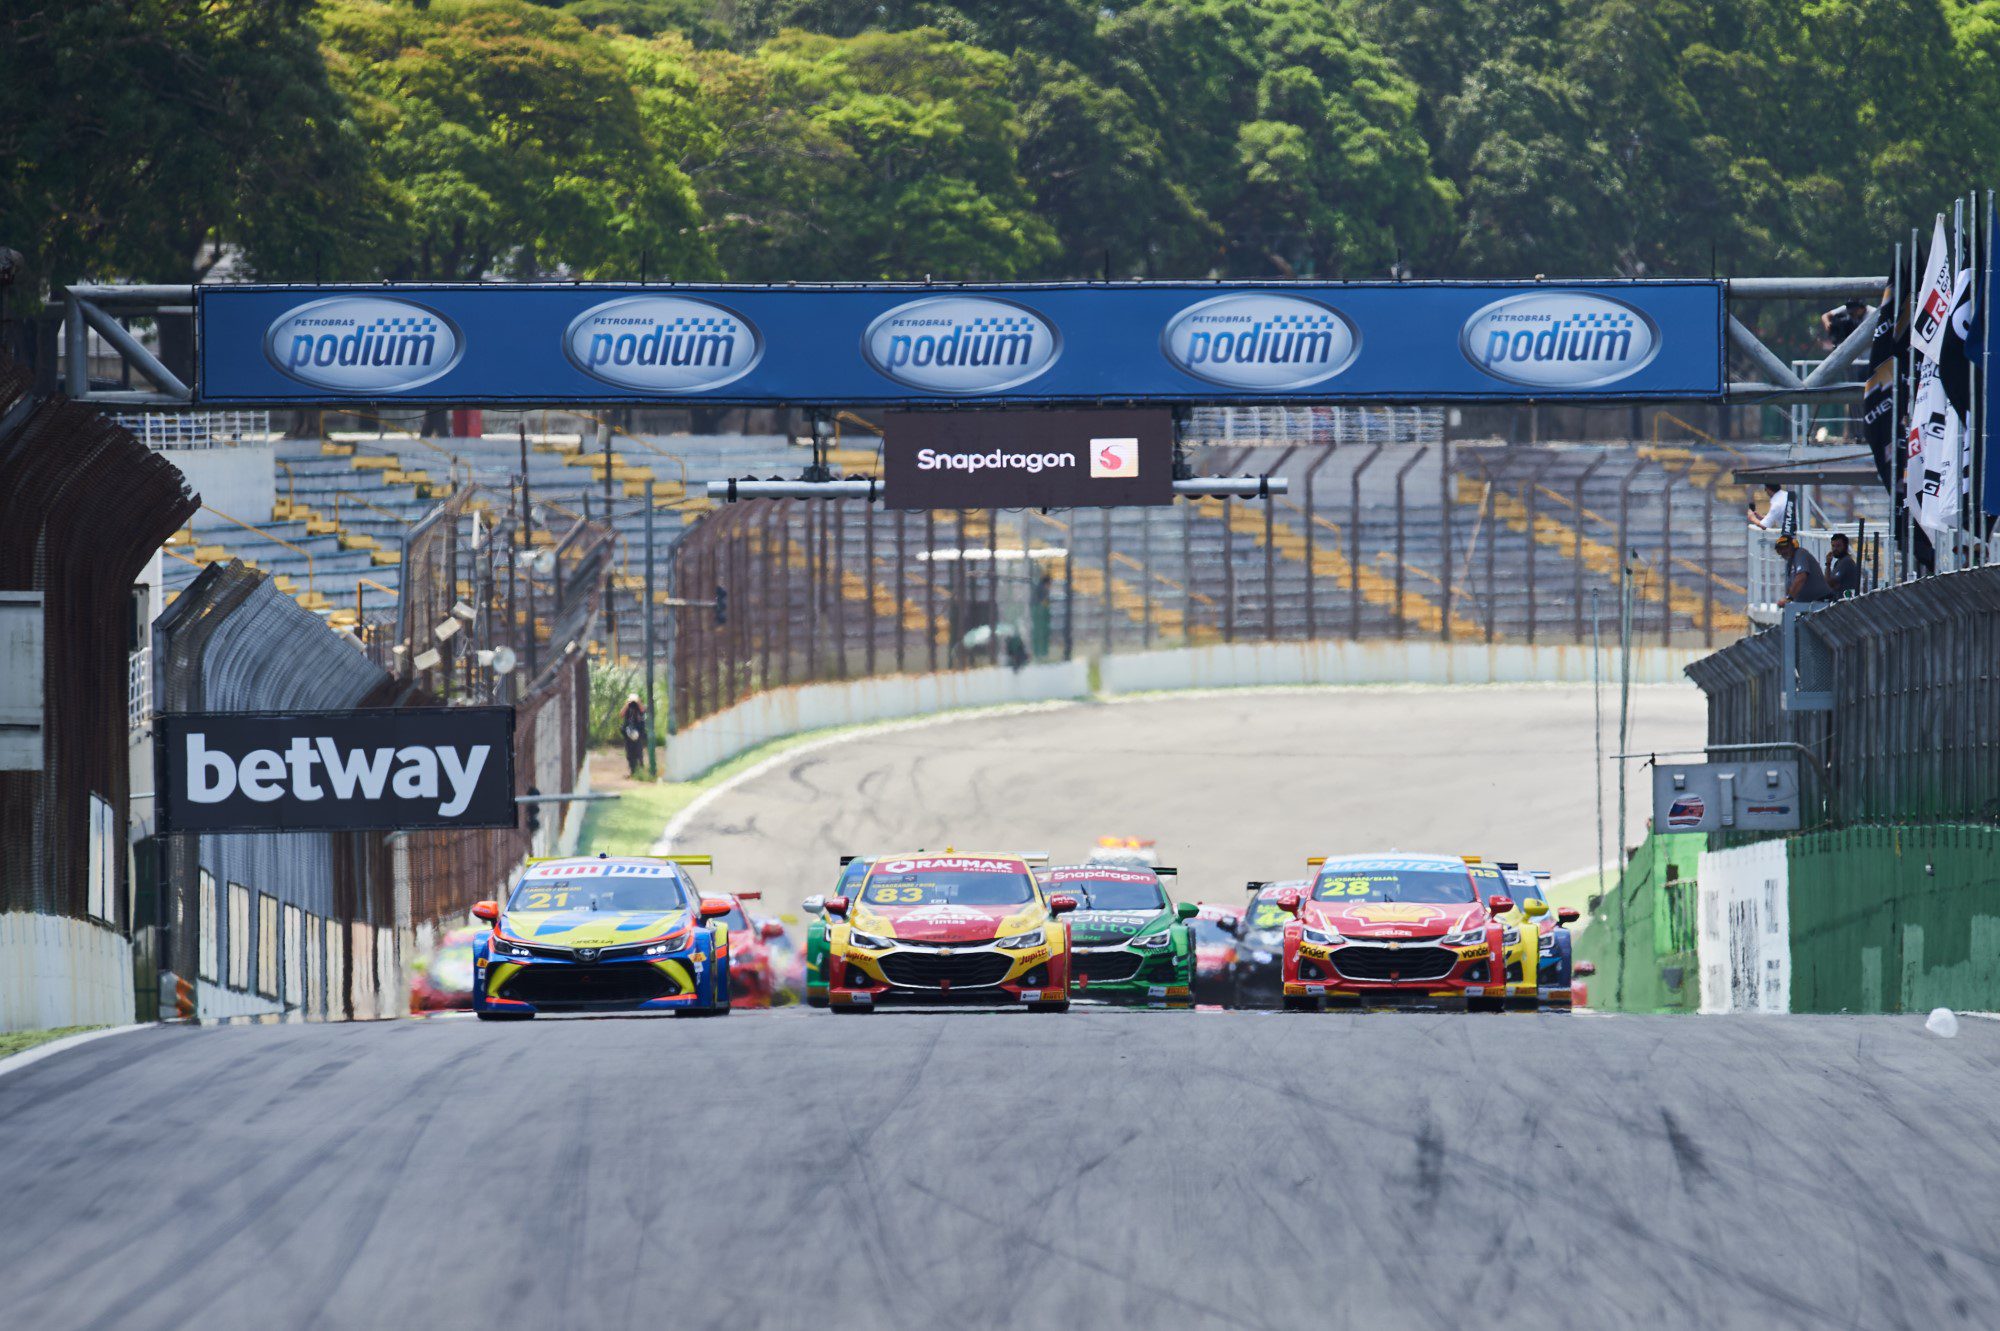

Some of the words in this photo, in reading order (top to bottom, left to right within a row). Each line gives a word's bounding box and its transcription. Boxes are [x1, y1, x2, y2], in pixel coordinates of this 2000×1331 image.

[294, 318, 356, 326] PETROBRAS
[593, 317, 655, 325] PETROBRAS
[891, 318, 954, 327] PETROBRAS
[1191, 315, 1253, 324] PETROBRAS
[1490, 314, 1552, 322] PETROBRAS
[287, 325, 436, 373] podium
[587, 324, 735, 371] podium
[886, 325, 1033, 372] podium
[1185, 322, 1334, 369] podium
[1484, 320, 1632, 368] podium
[917, 448, 1076, 474] Snapdragon
[186, 732, 491, 817] betway
[916, 859, 1014, 871] RAUMAK
[1054, 871, 1151, 881] Snapdragon
[875, 887, 924, 903] 83
[1321, 881, 1371, 896] 28
[527, 892, 569, 908] 21
